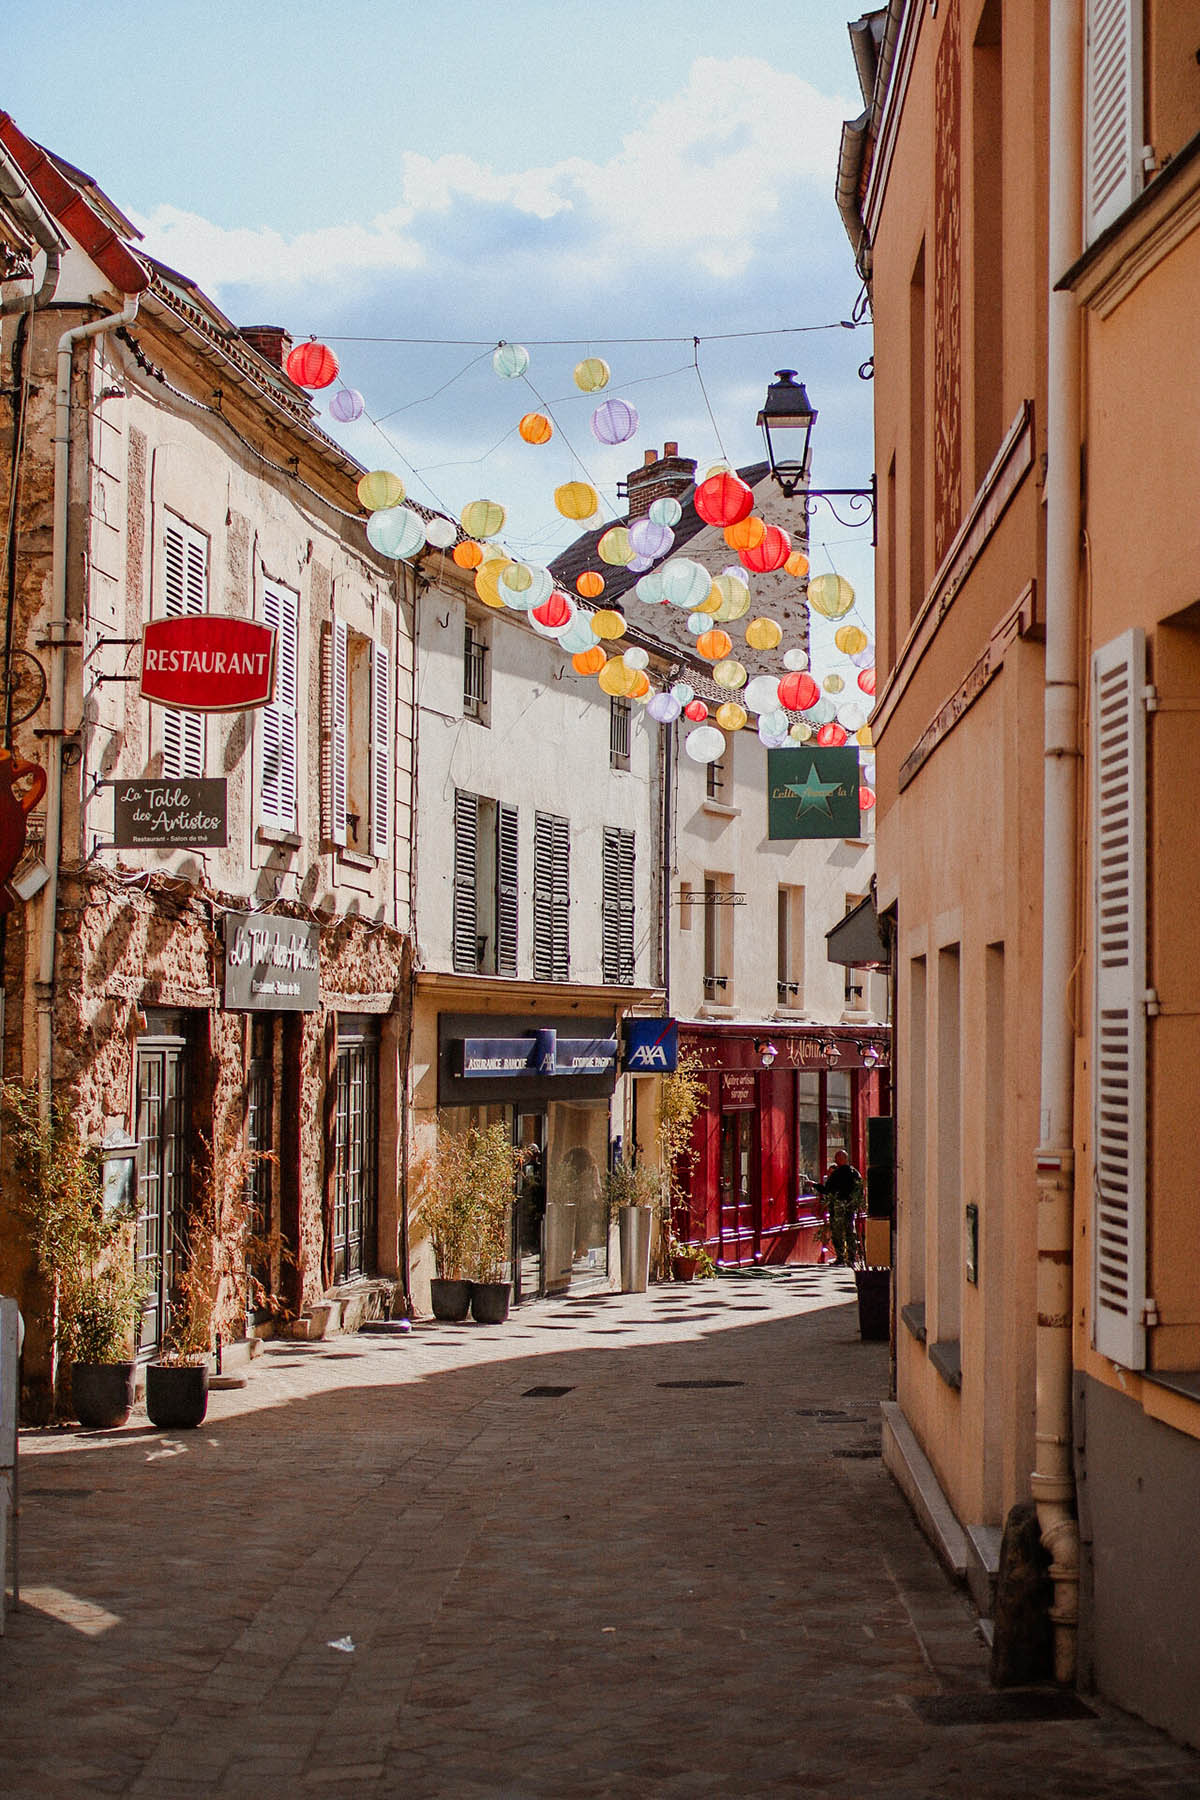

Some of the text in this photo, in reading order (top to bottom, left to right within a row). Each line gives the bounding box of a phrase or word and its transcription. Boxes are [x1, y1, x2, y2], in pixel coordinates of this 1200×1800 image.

[145, 649, 268, 676] RESTAURANT
[120, 787, 190, 809] La Table
[132, 808, 222, 832] des Artistes
[132, 835, 166, 843] Restaurant
[467, 1058, 528, 1070] ASSURANCE BANQUE
[628, 1045, 668, 1066] AXA
